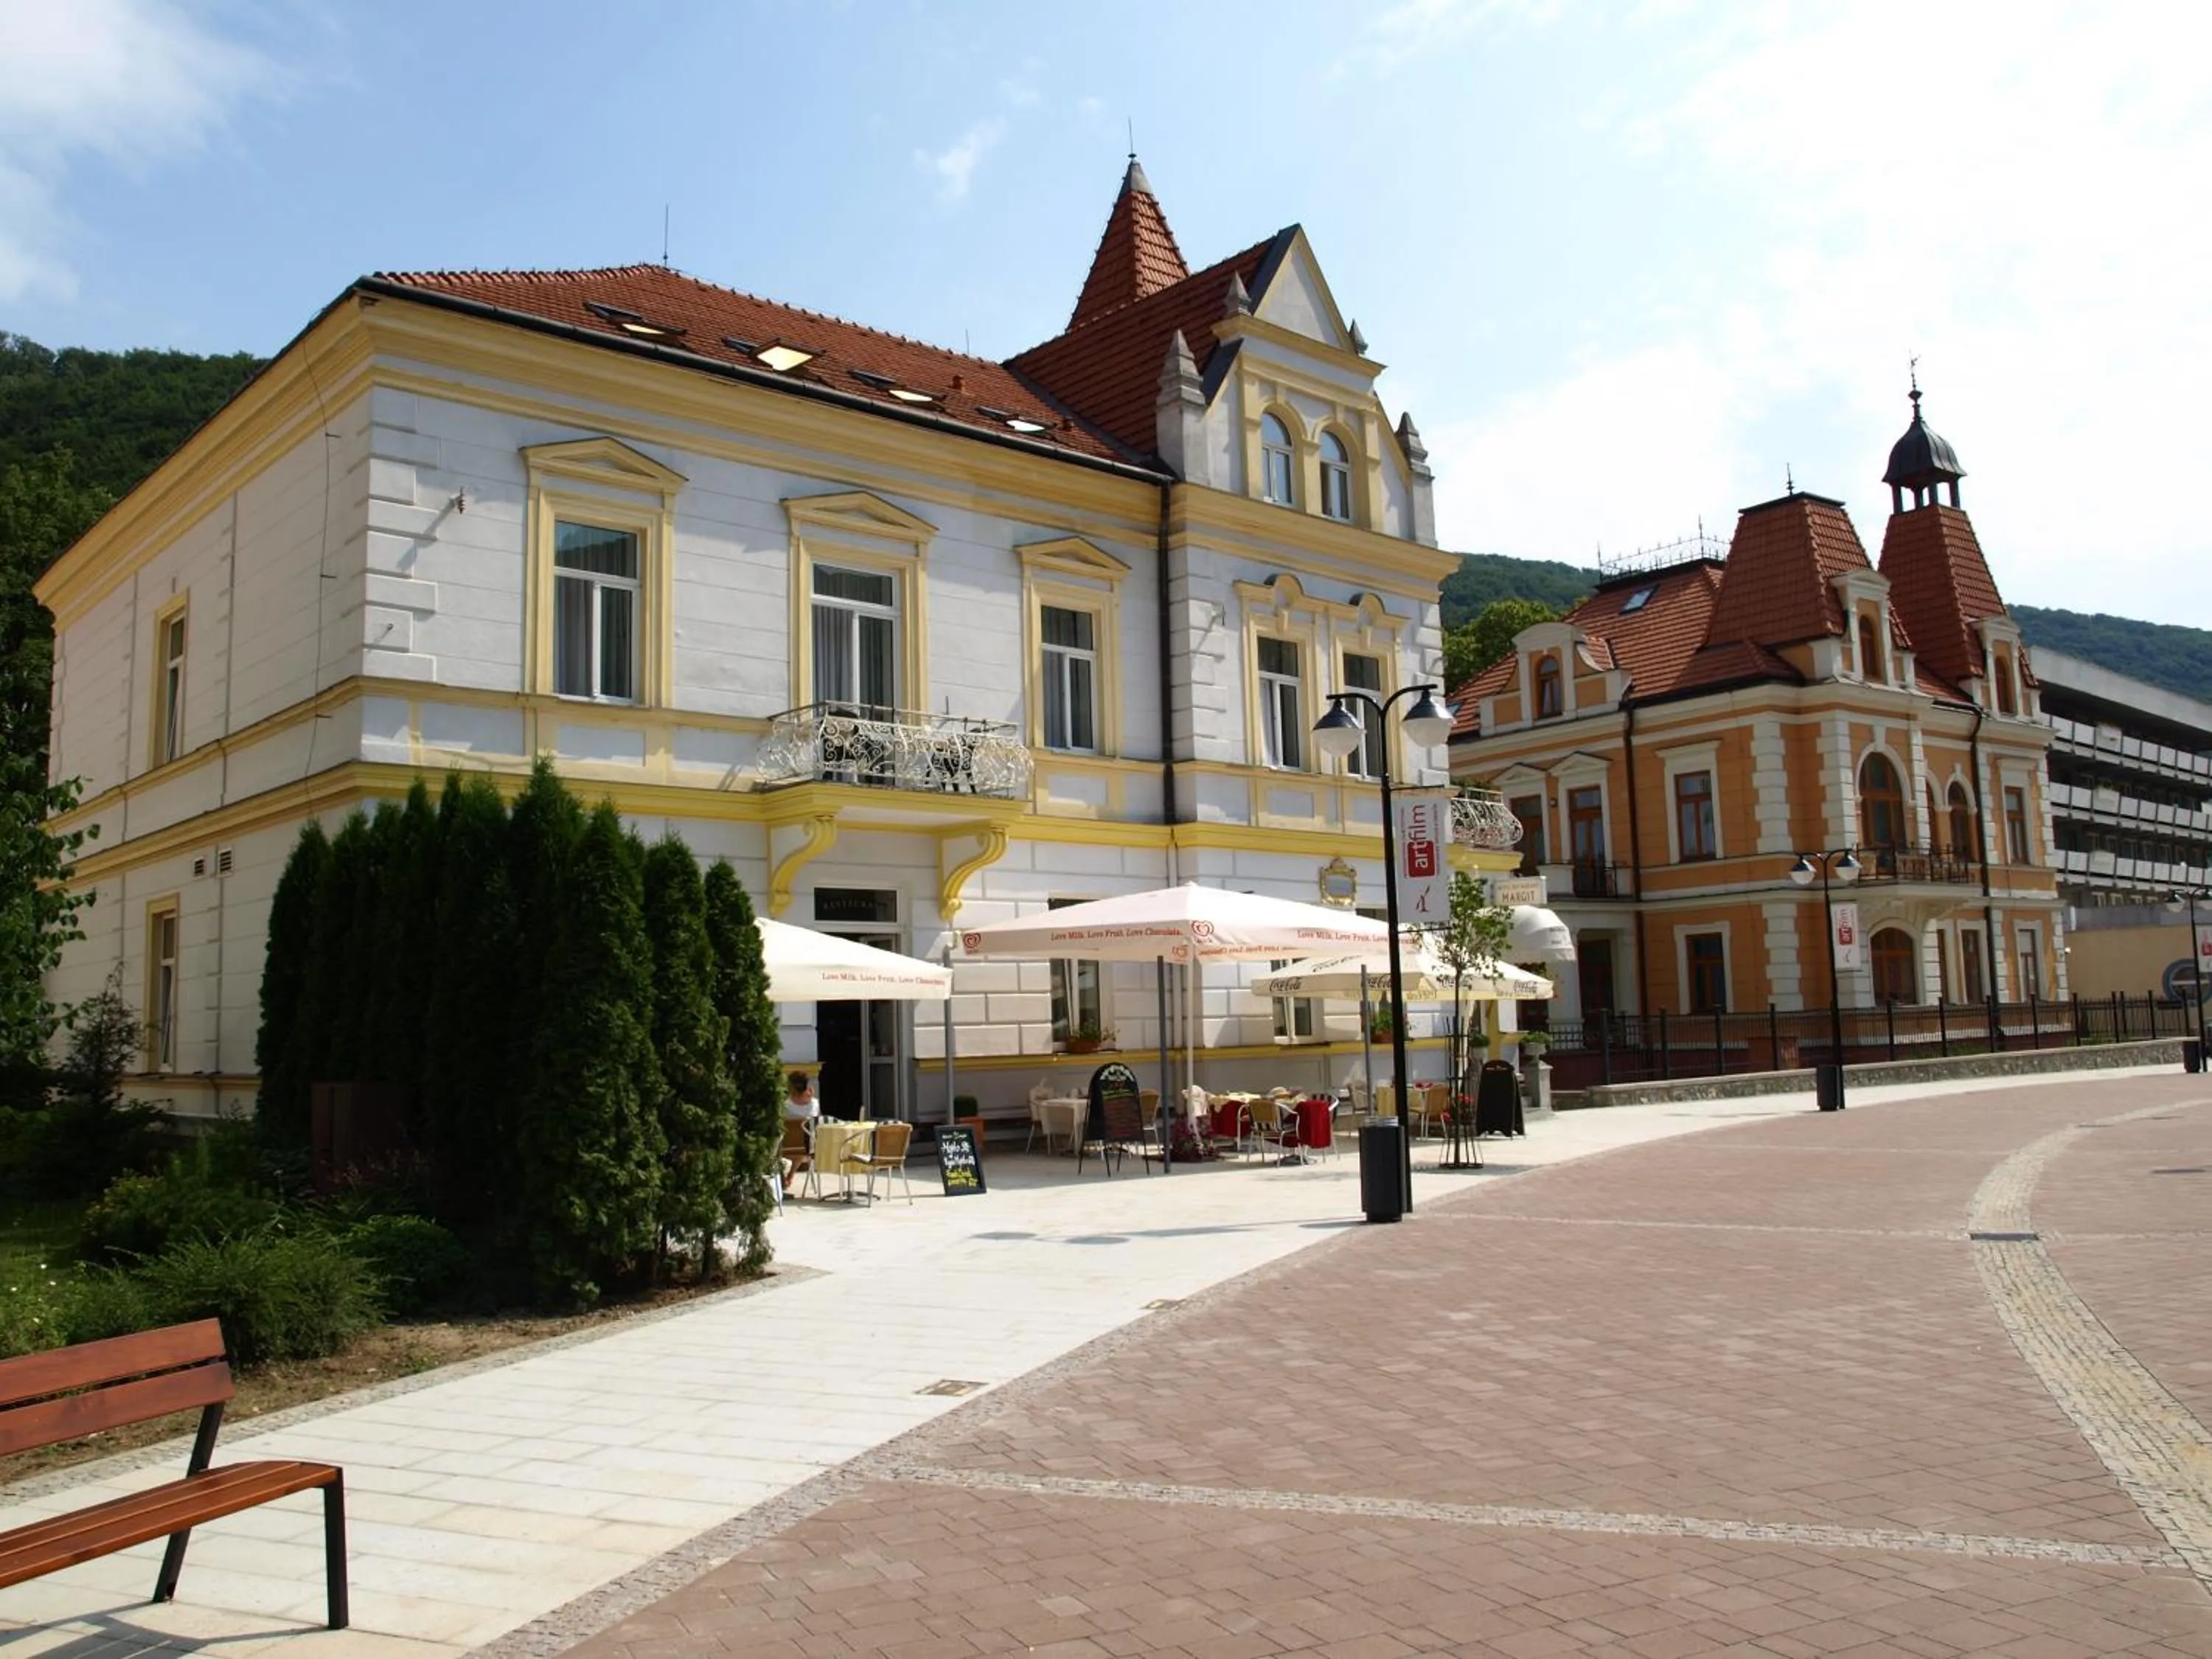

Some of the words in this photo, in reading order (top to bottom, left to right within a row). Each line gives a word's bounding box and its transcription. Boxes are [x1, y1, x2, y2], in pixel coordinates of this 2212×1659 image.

[1408, 804, 1428, 869] artfilm
[1501, 891, 1534, 903] MARGIT
[1051, 932, 1066, 941] Love
[1088, 930, 1104, 939] Love
[1126, 928, 1143, 937] Love
[1297, 931, 1314, 939] Love
[1335, 932, 1351, 941] Love
